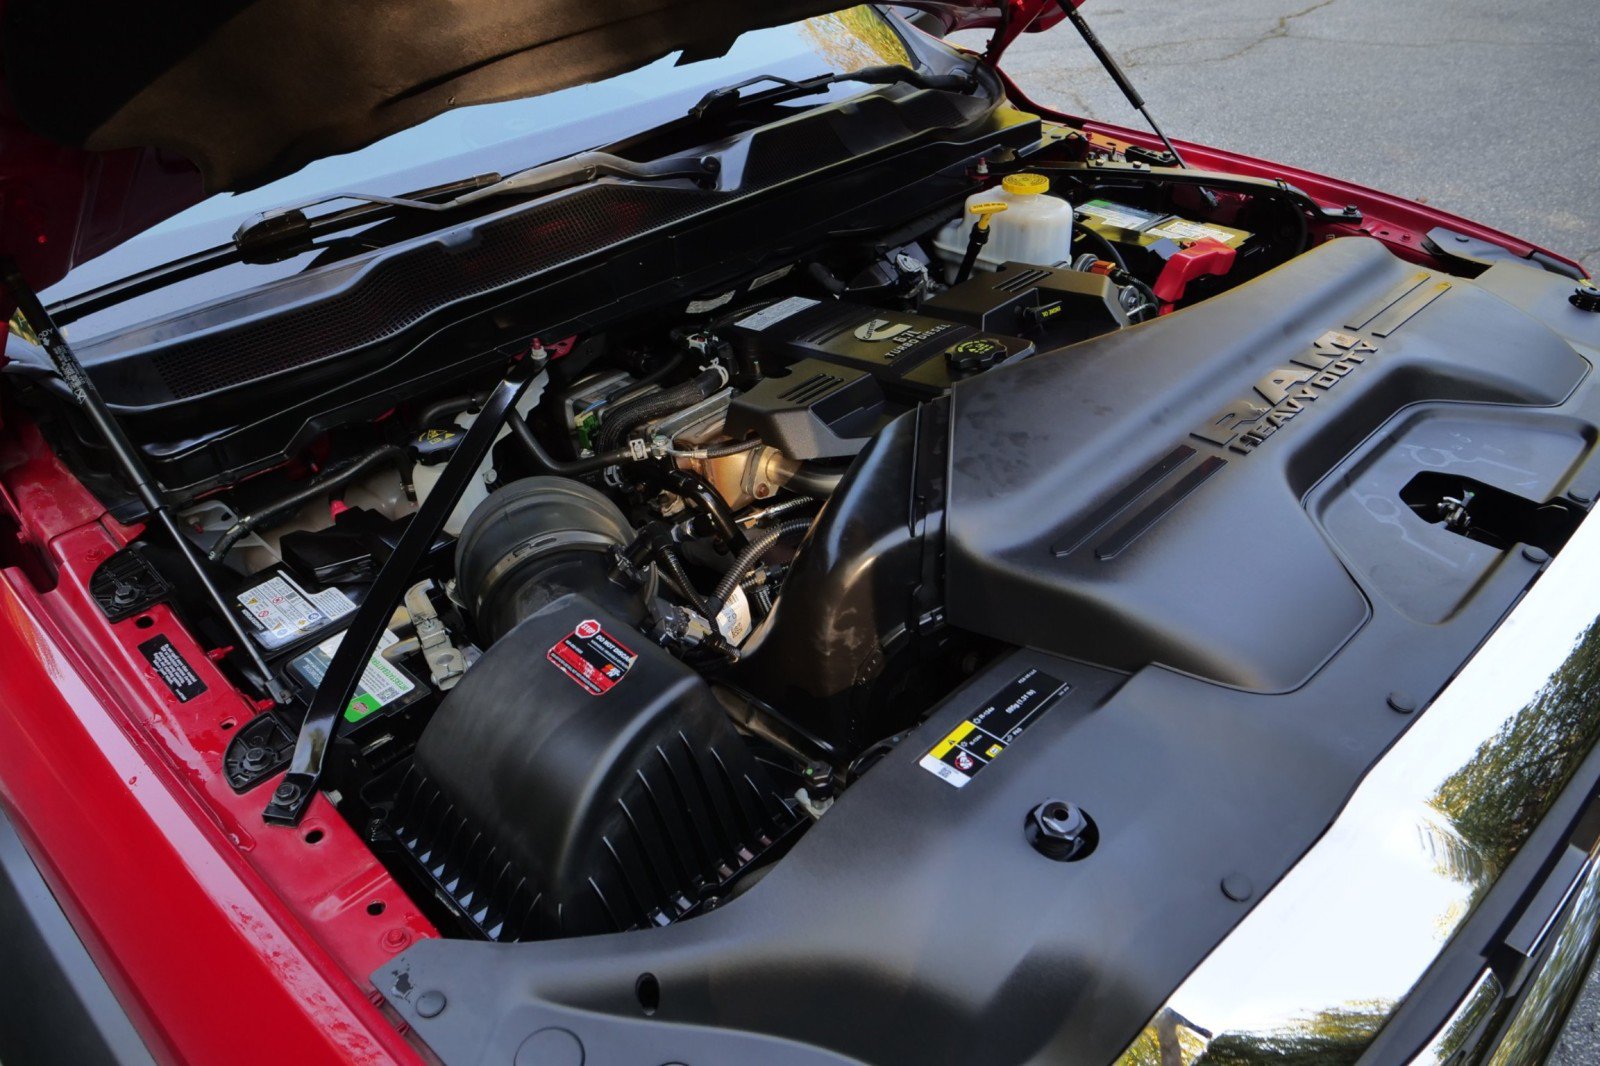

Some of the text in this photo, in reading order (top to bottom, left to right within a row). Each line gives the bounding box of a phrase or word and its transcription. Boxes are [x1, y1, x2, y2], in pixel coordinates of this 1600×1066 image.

[884, 323, 952, 358] TURBO DIESEL
[892, 330, 922, 343] 6.7L
[1189, 330, 1361, 447] RAM
[1229, 339, 1379, 455] HEAVY DUTY
[595, 634, 605, 643] DO
[603, 639, 616, 651] NOT
